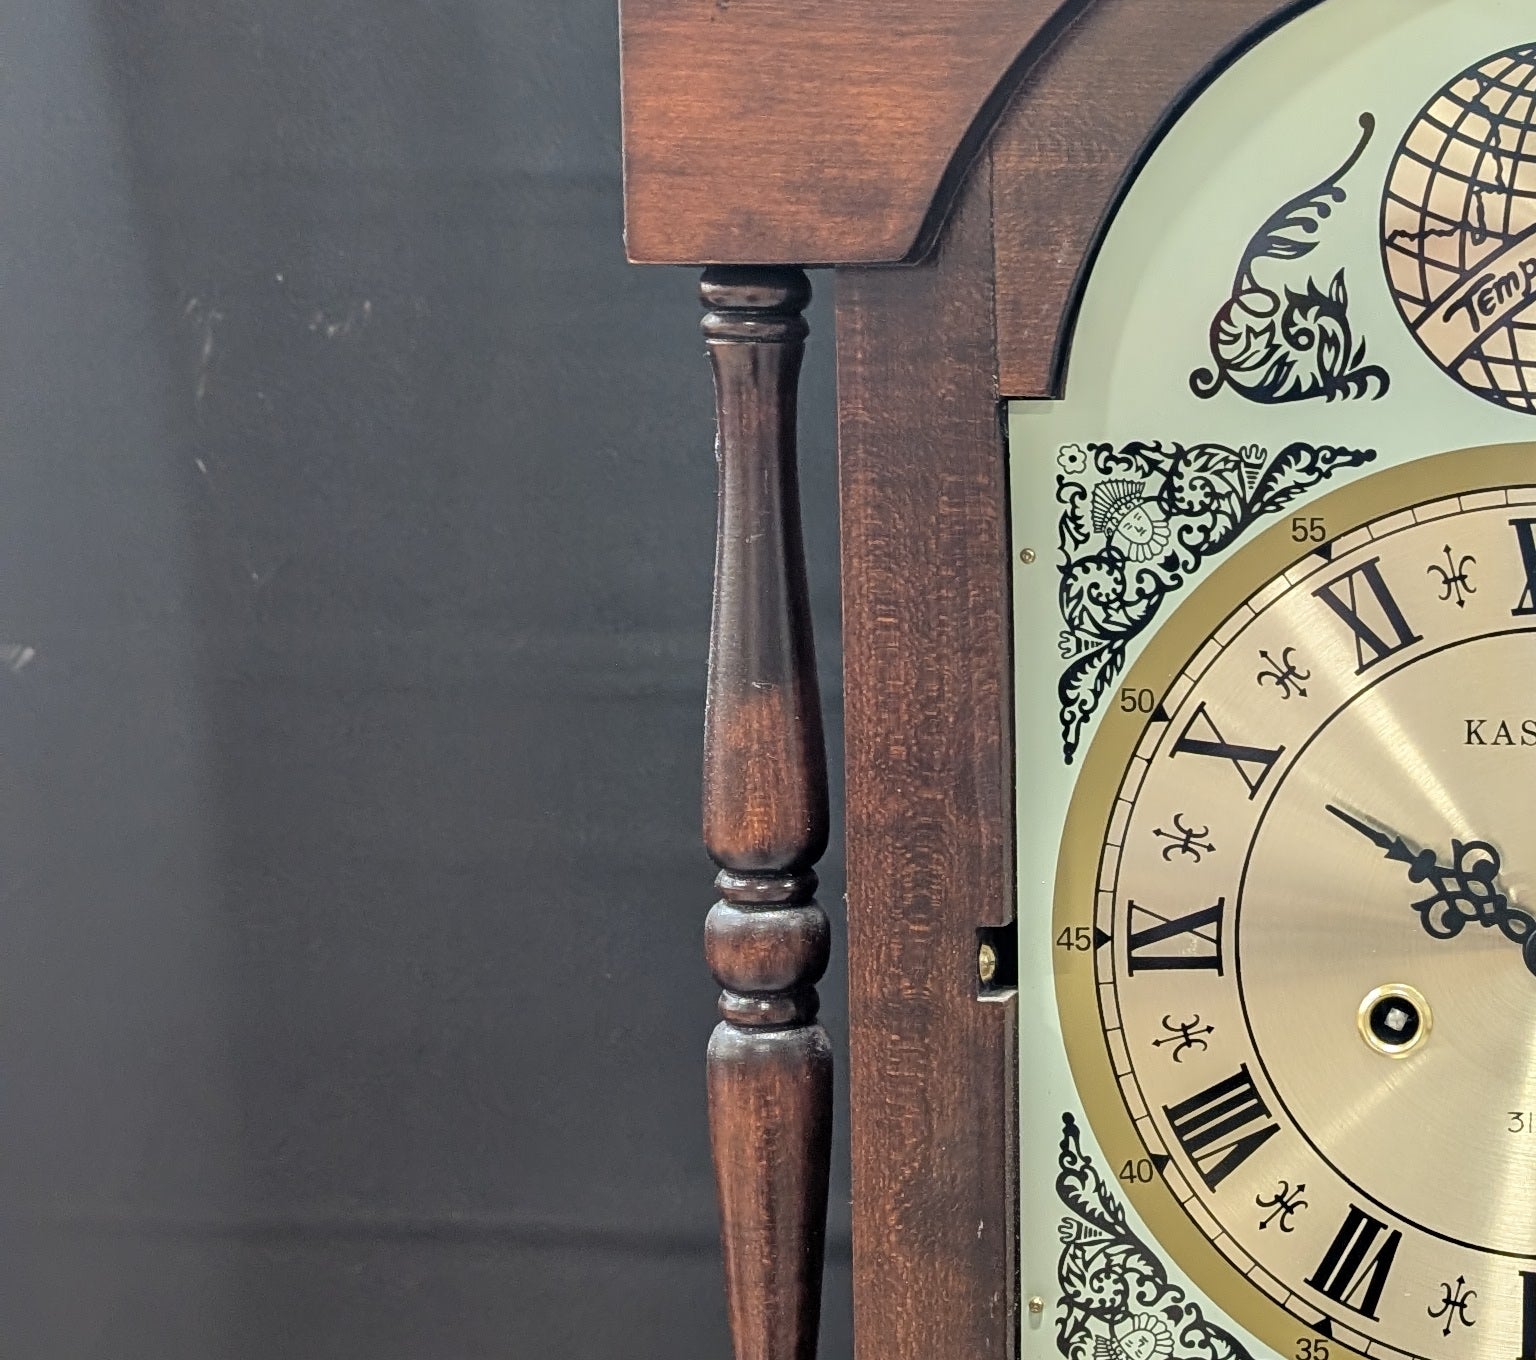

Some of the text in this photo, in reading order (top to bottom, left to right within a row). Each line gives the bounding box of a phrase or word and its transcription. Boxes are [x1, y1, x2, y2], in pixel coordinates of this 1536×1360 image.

[1290, 516, 1327, 542] 55
[1311, 555, 1424, 676] XI
[1120, 688, 1156, 715] 50
[1168, 701, 1287, 801] X
[1056, 928, 1092, 953] 45
[1127, 896, 1226, 978] IX
[1161, 1062, 1282, 1194] VIII
[1507, 1111, 1534, 1134] 31
[1119, 1158, 1155, 1185] 40
[1304, 1203, 1403, 1323] VII
